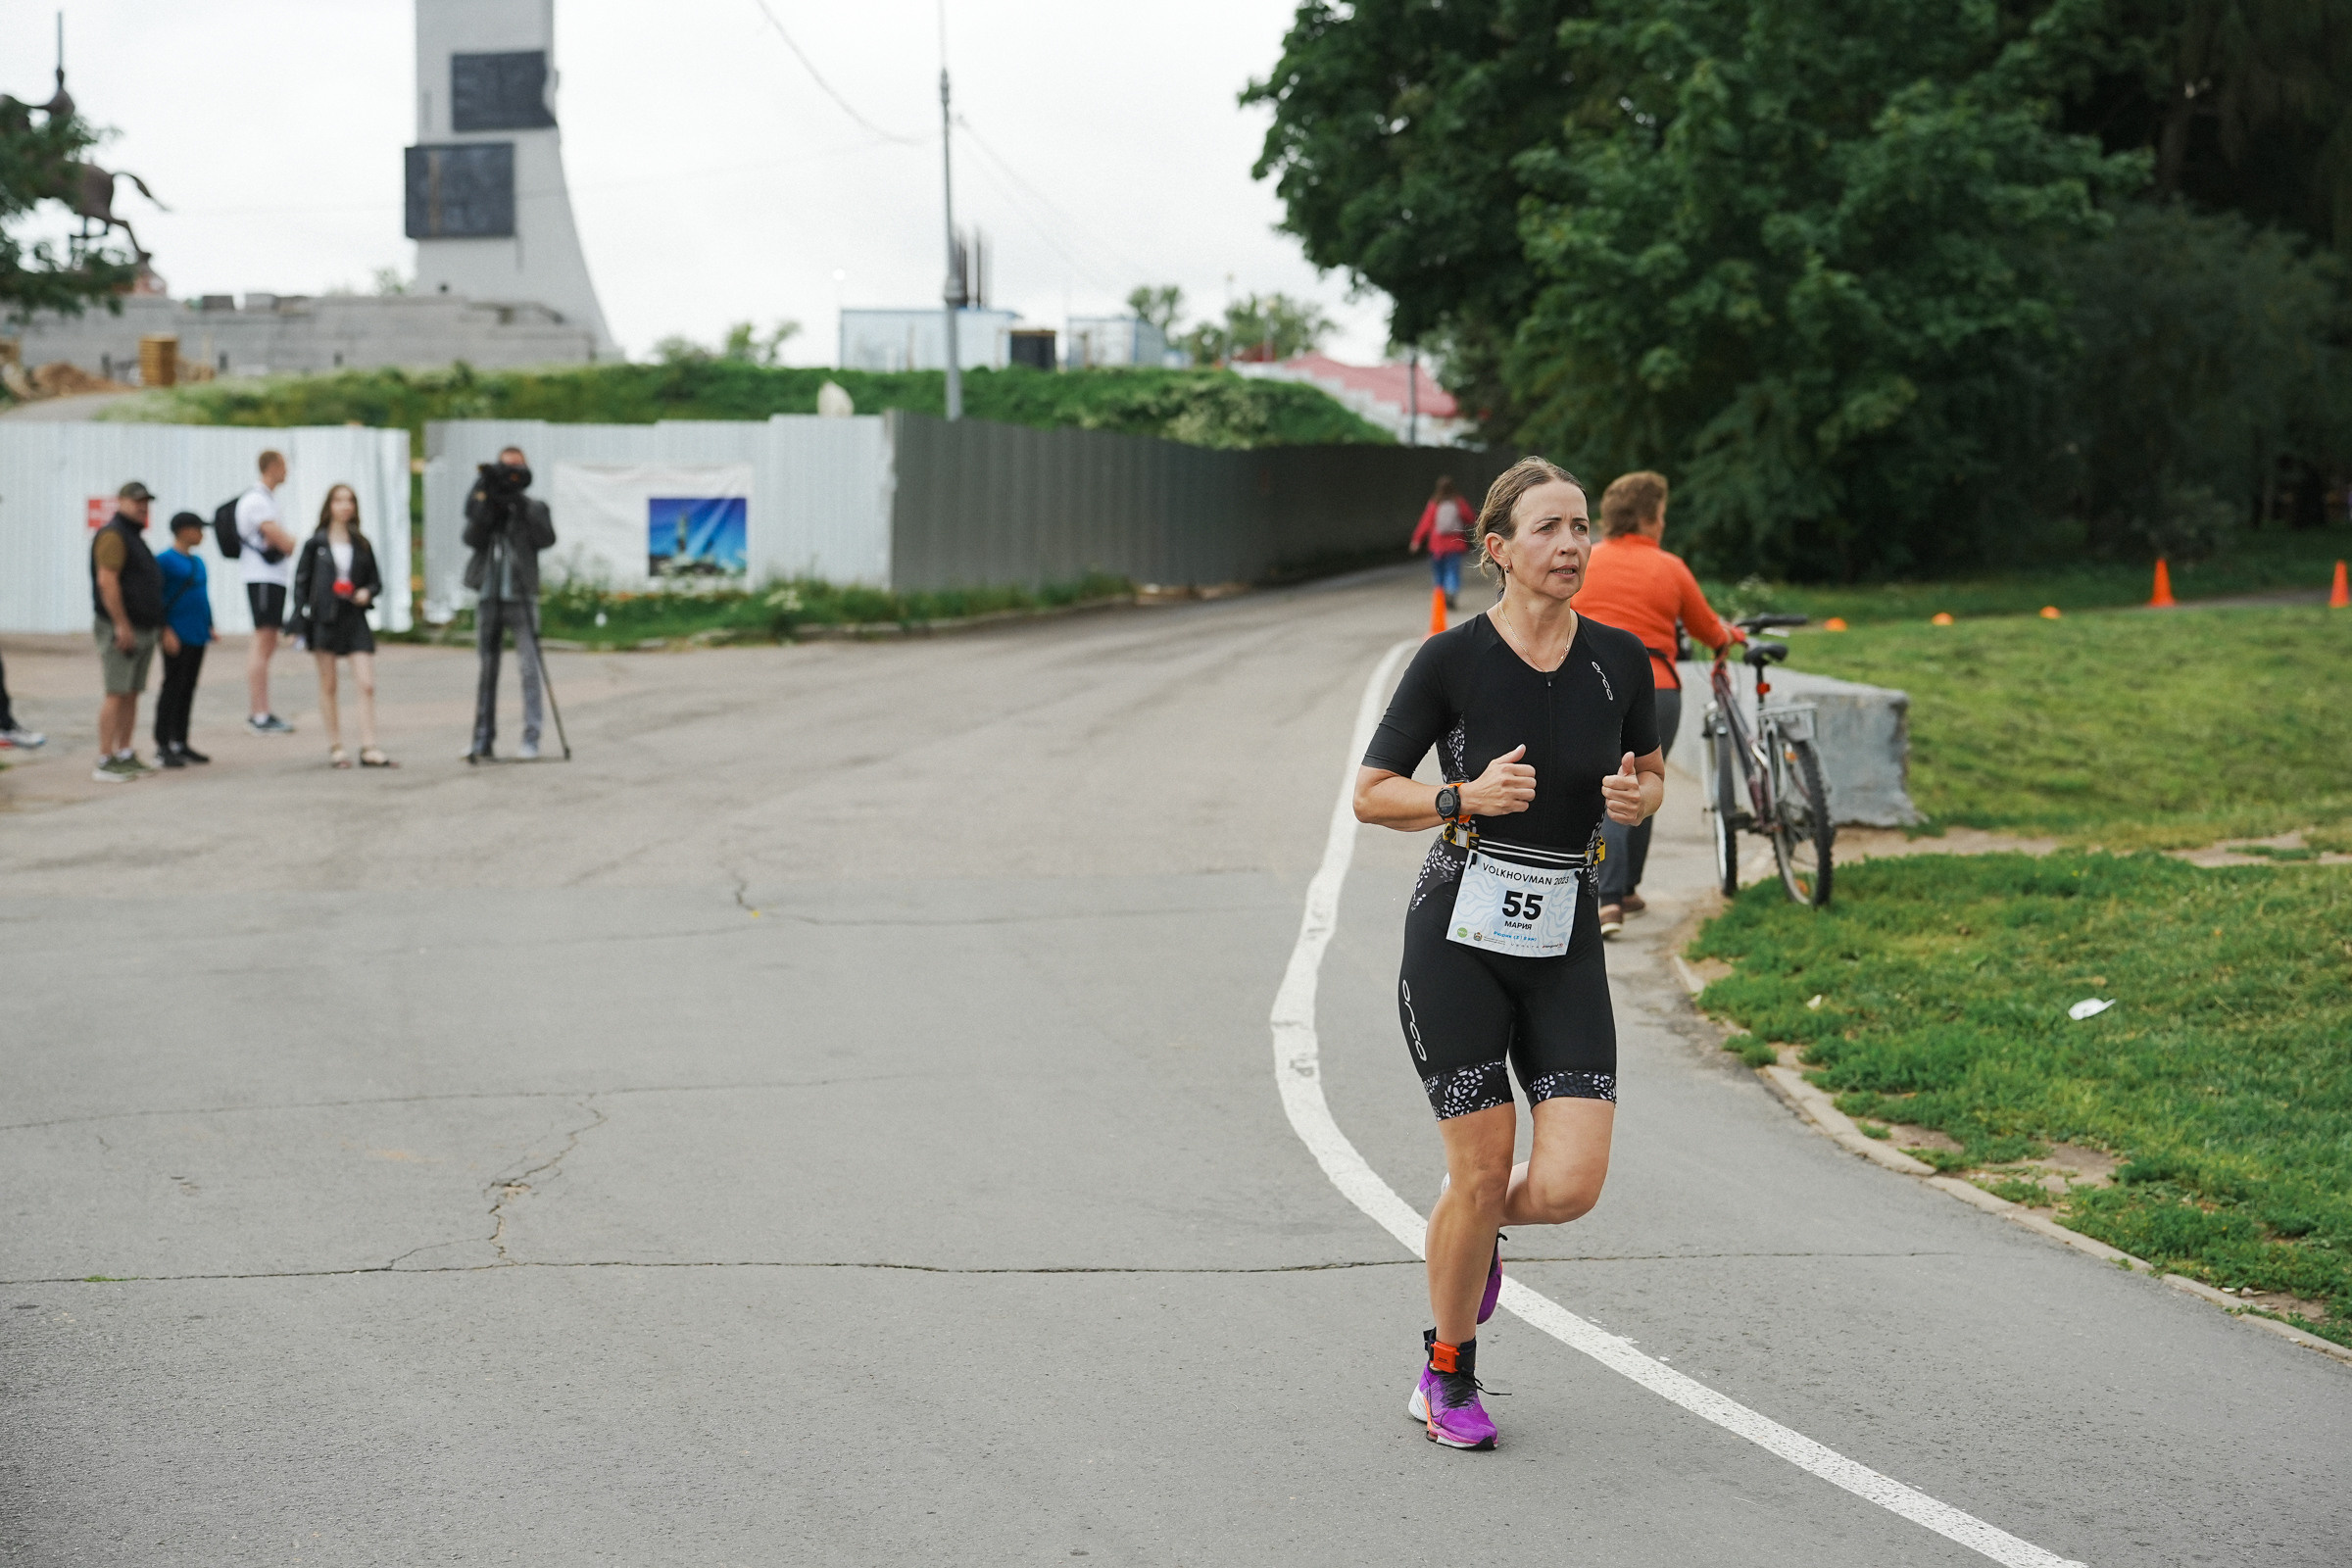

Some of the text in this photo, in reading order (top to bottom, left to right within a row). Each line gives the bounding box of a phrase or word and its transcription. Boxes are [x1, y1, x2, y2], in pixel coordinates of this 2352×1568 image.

[1483, 862, 1569, 886] VOLKHOVMAN 2023
[1501, 890, 1544, 920] 55
[1504, 920, 1533, 930] МАРИЯ
